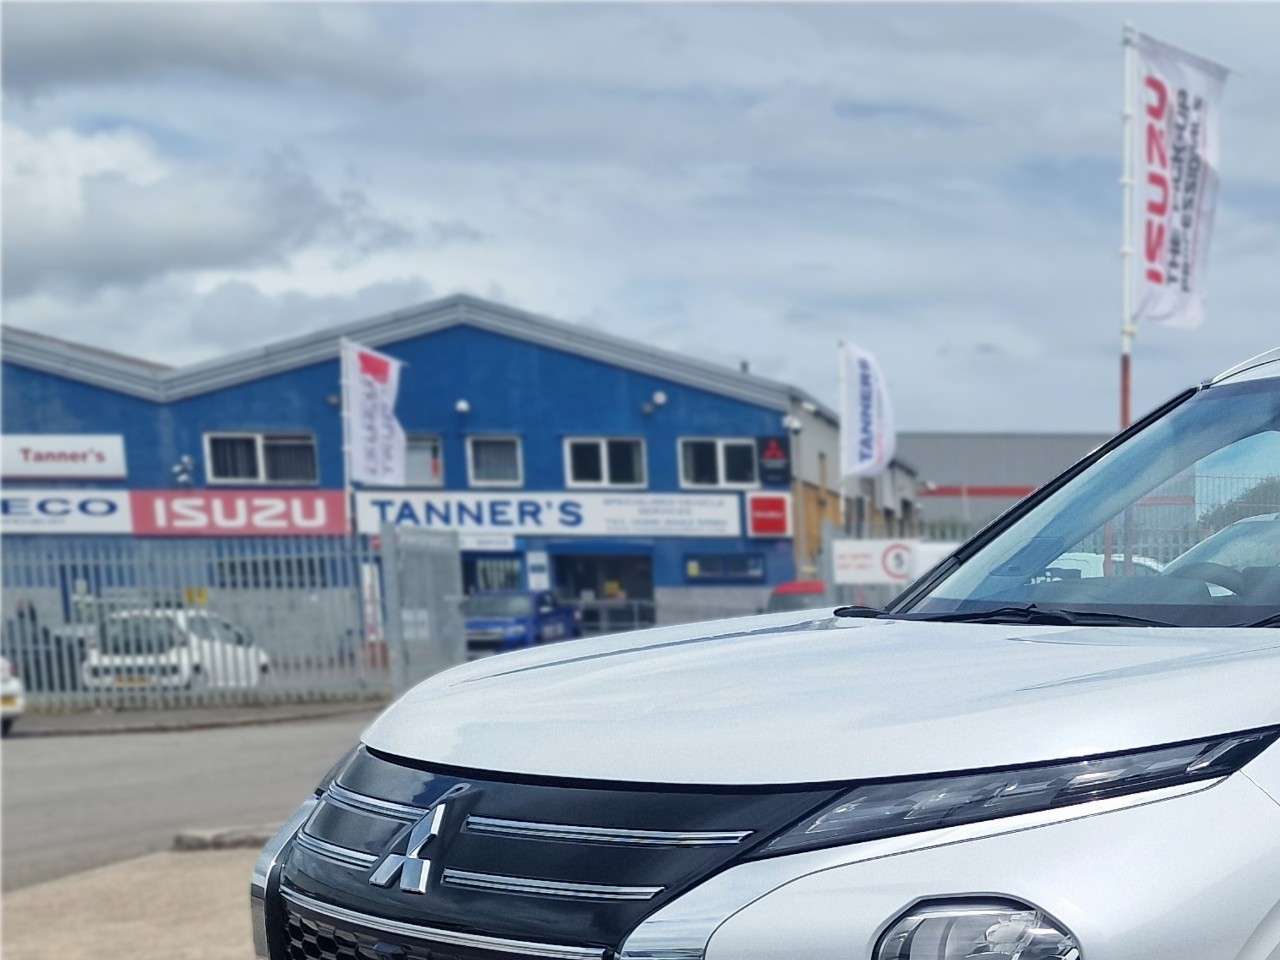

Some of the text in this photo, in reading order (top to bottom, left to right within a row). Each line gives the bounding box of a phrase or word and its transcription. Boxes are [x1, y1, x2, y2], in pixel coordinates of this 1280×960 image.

[1144, 75, 1168, 285] ISUZU
[20, 448, 106, 463] Tanner's
[154, 498, 327, 529] ISUZU
[370, 499, 584, 527] TANNER'S
